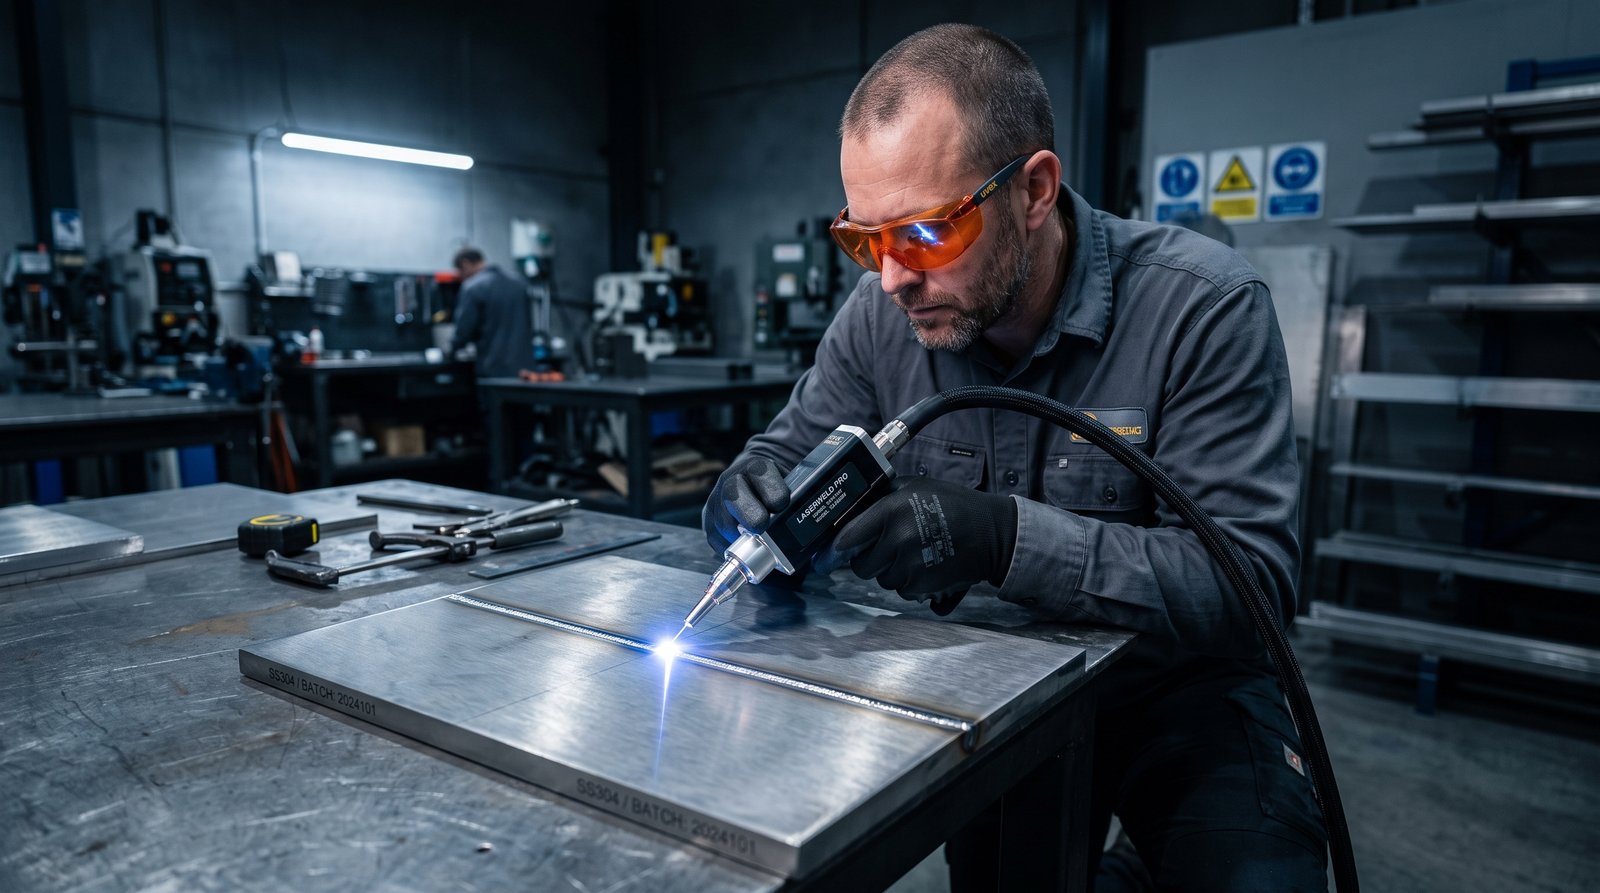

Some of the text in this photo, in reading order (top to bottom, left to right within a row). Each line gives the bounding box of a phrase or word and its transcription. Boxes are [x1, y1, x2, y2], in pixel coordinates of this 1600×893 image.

[980, 180, 998, 198] uvex
[796, 485, 835, 524] LASERWELD
[834, 472, 849, 488] PRO
[269, 668, 295, 686] SS304
[302, 679, 335, 701] BATCH:
[338, 692, 376, 716] 2024101
[576, 778, 620, 806] SS304
[632, 797, 687, 829] BATCH:
[691, 818, 756, 856] 2024101
